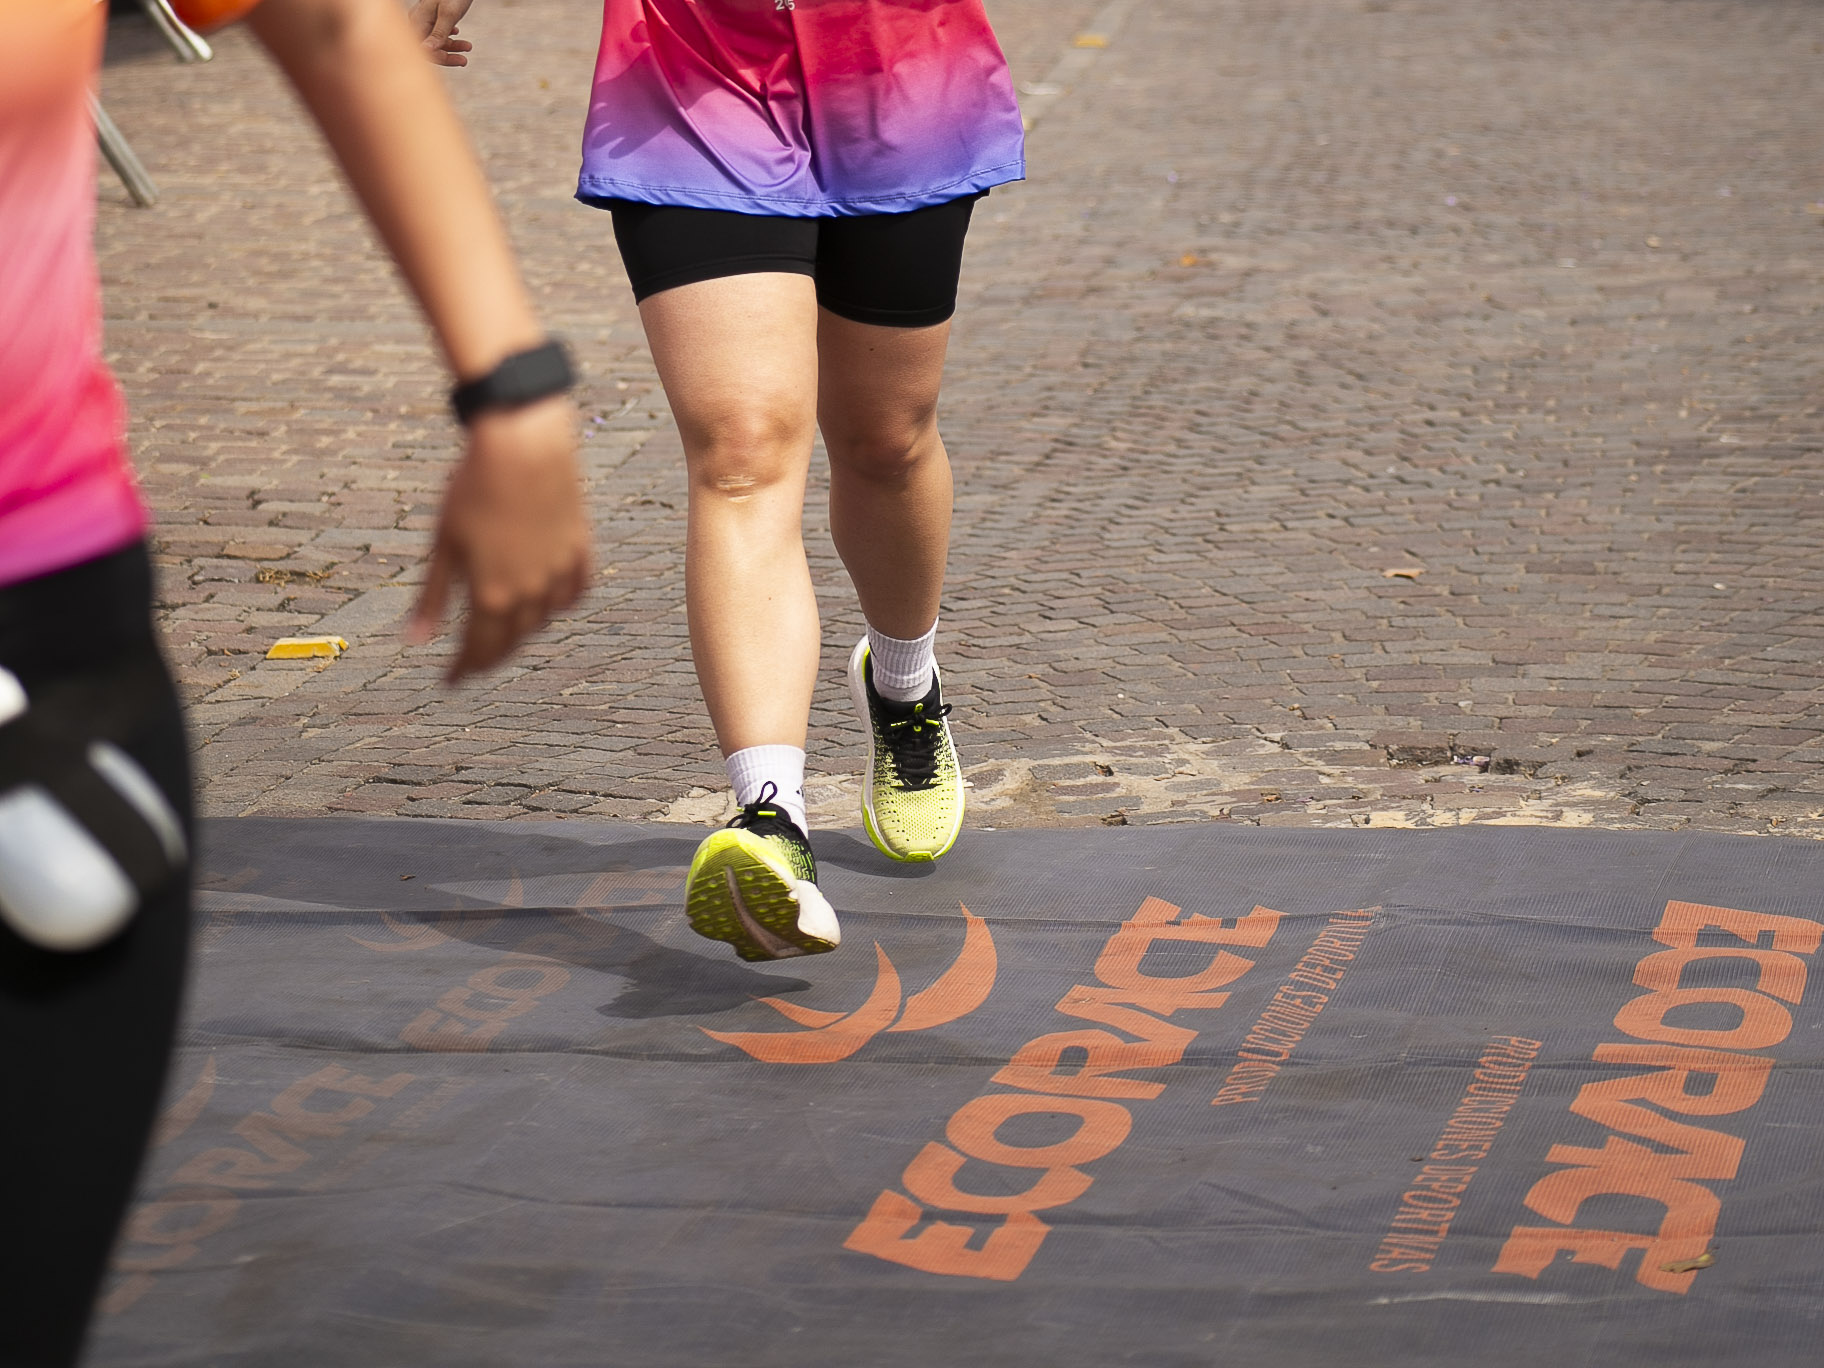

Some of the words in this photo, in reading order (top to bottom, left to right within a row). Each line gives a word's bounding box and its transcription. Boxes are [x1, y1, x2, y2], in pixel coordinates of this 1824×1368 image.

[842, 895, 1291, 1282] ECORACE
[1210, 984, 1330, 1106] PRODUCCIONES
[1430, 1034, 1543, 1161] PRODUCCIONES
[1490, 899, 1824, 1295] ECORACE
[1368, 1165, 1479, 1274] DEPORTIVAS
